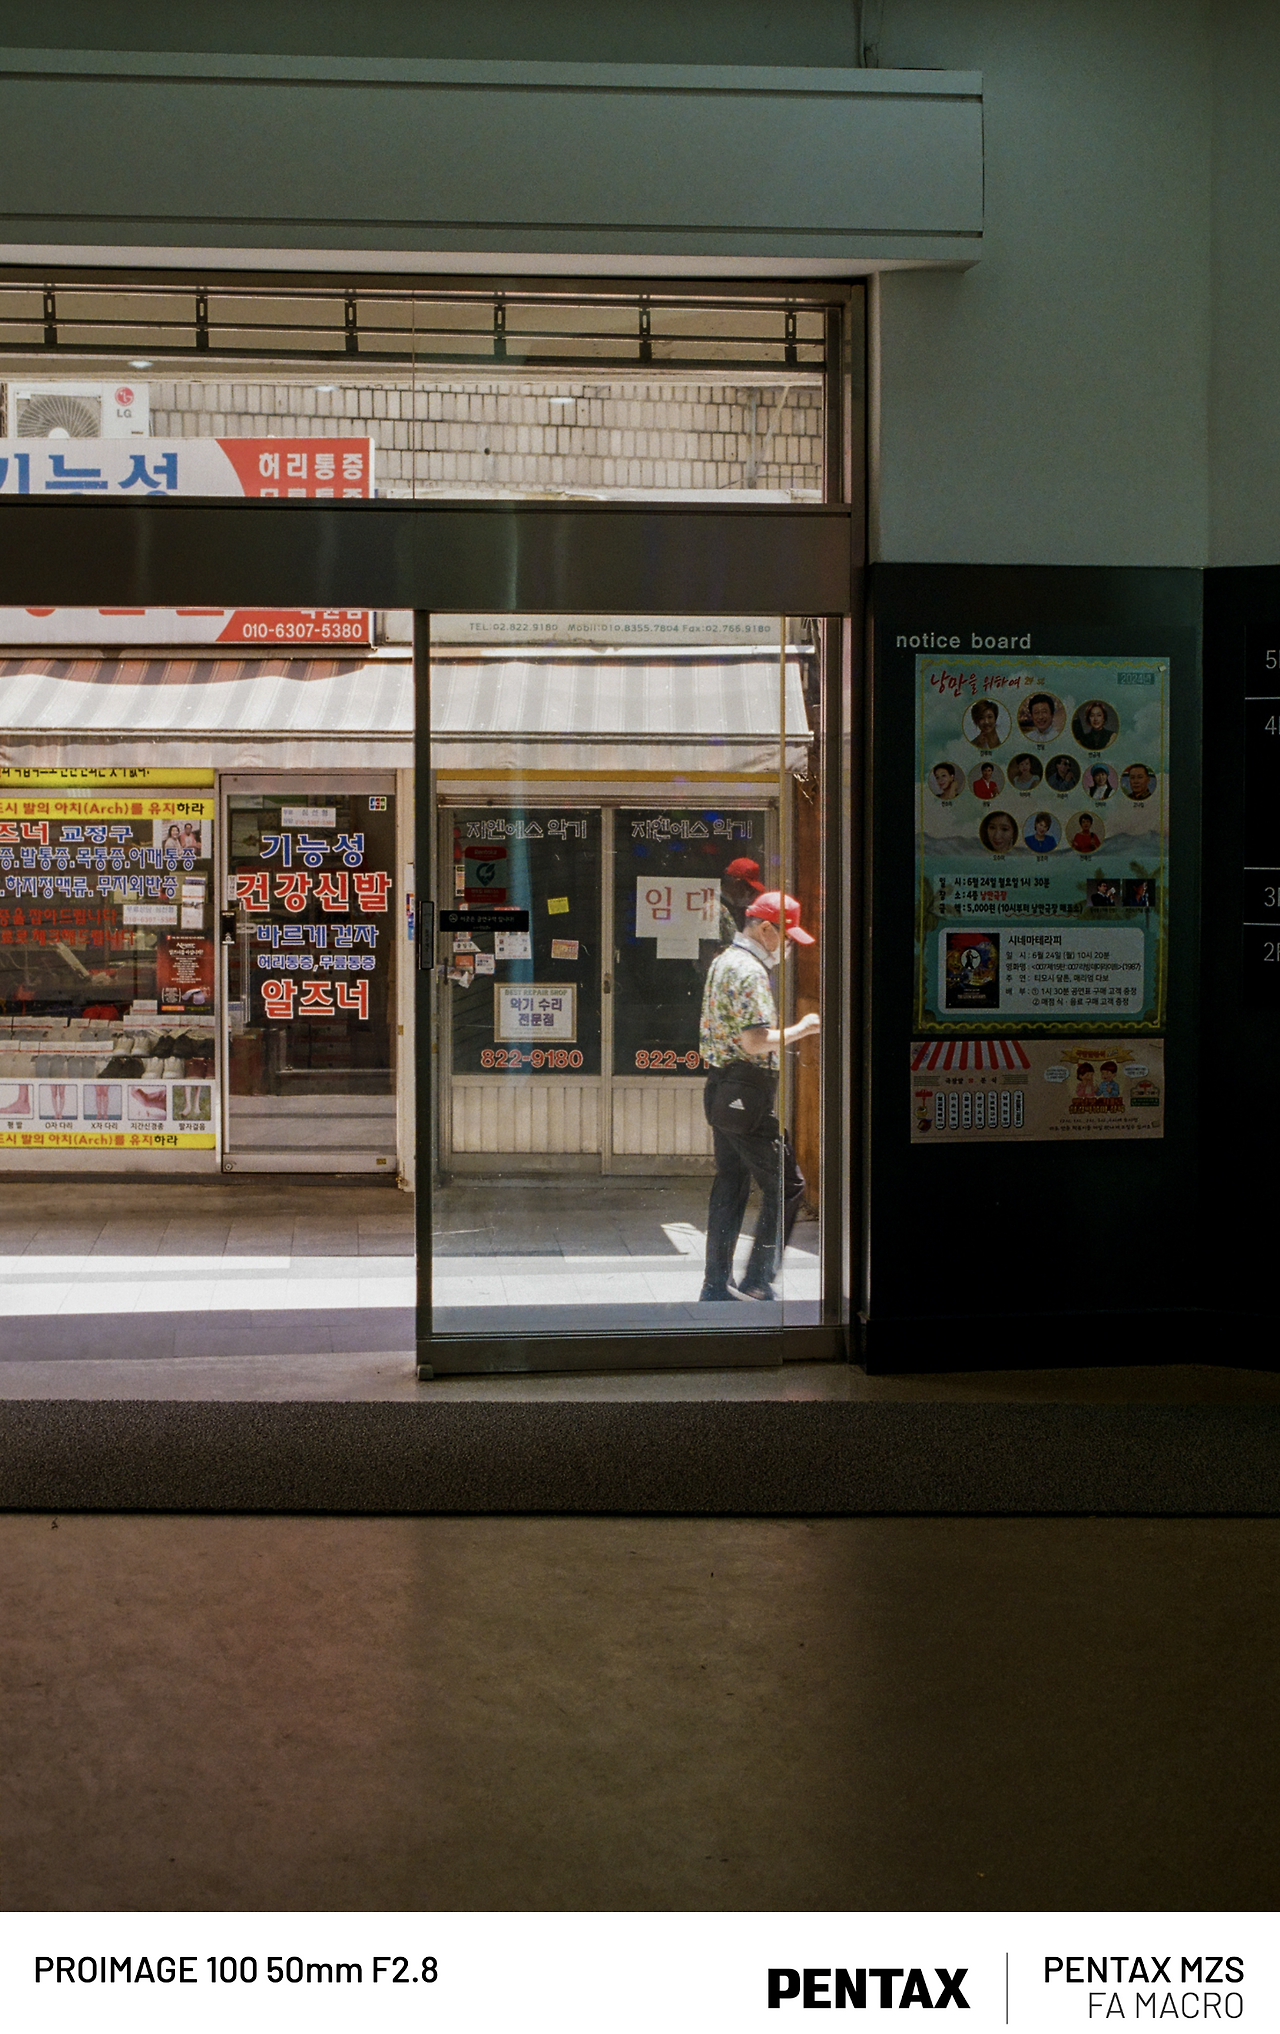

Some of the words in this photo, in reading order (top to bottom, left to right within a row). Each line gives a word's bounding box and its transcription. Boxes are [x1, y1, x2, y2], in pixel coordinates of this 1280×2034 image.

[117, 409, 132, 418] LG
[258, 453, 363, 480] 허리통증
[242, 623, 362, 639] 010-6307-5380
[896, 632, 961, 648] notice
[971, 632, 1031, 649] board
[930, 670, 978, 698] 낭만을
[983, 676, 1021, 692] 위하여
[23, 802, 49, 815] 발의
[148, 802, 204, 816] 유지하라
[59, 825, 133, 844] 교정구
[547, 818, 587, 841] 악기
[712, 818, 753, 841] 악기
[260, 833, 364, 867] 기능성
[236, 872, 392, 912] 건강신발
[980, 878, 997, 889] 24일
[257, 925, 327, 948] 바르게
[331, 925, 379, 948] 걷자
[1008, 935, 1062, 946] 시네마테라피
[1045, 951, 1062, 960] 24일
[261, 979, 369, 1020] 알즈너
[510, 998, 534, 1011] 악기
[538, 998, 562, 1011] 수리
[518, 1013, 555, 1027] 전문점
[480, 1049, 584, 1069] 822-9180
[21, 1133, 45, 1145] 발의
[129, 1134, 179, 1146] 유지하라
